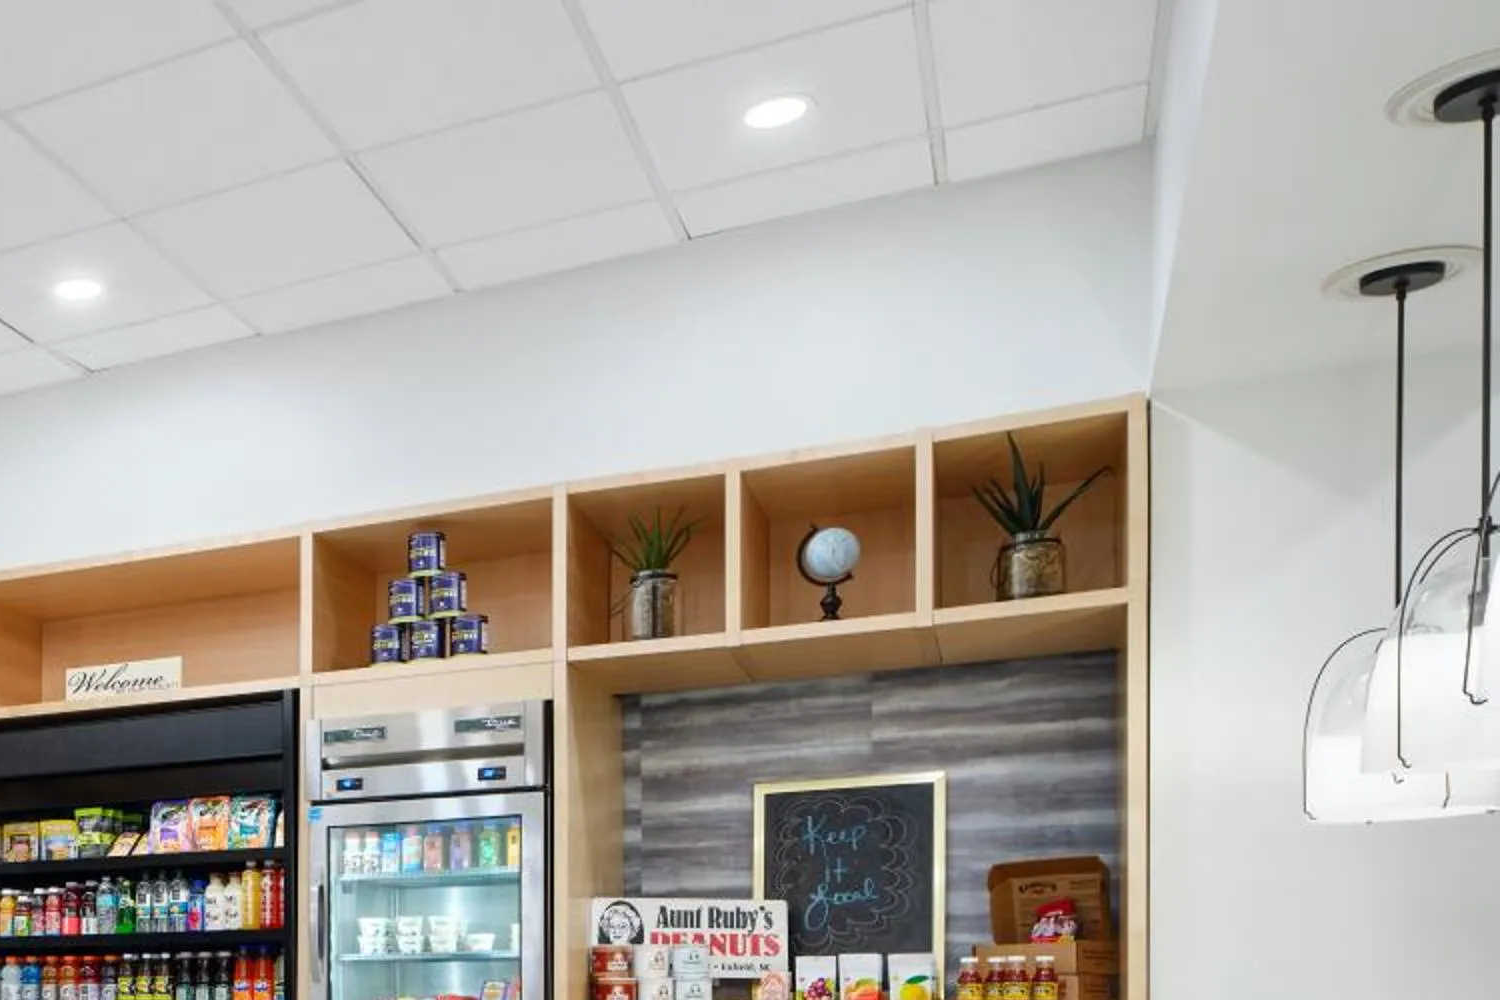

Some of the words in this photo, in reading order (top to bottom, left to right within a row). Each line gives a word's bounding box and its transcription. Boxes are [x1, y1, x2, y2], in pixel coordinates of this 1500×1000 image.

[67, 663, 164, 694] Welcome
[803, 816, 868, 856] Keep
[656, 905, 701, 929] Aunt
[708, 905, 773, 933] Ruby's
